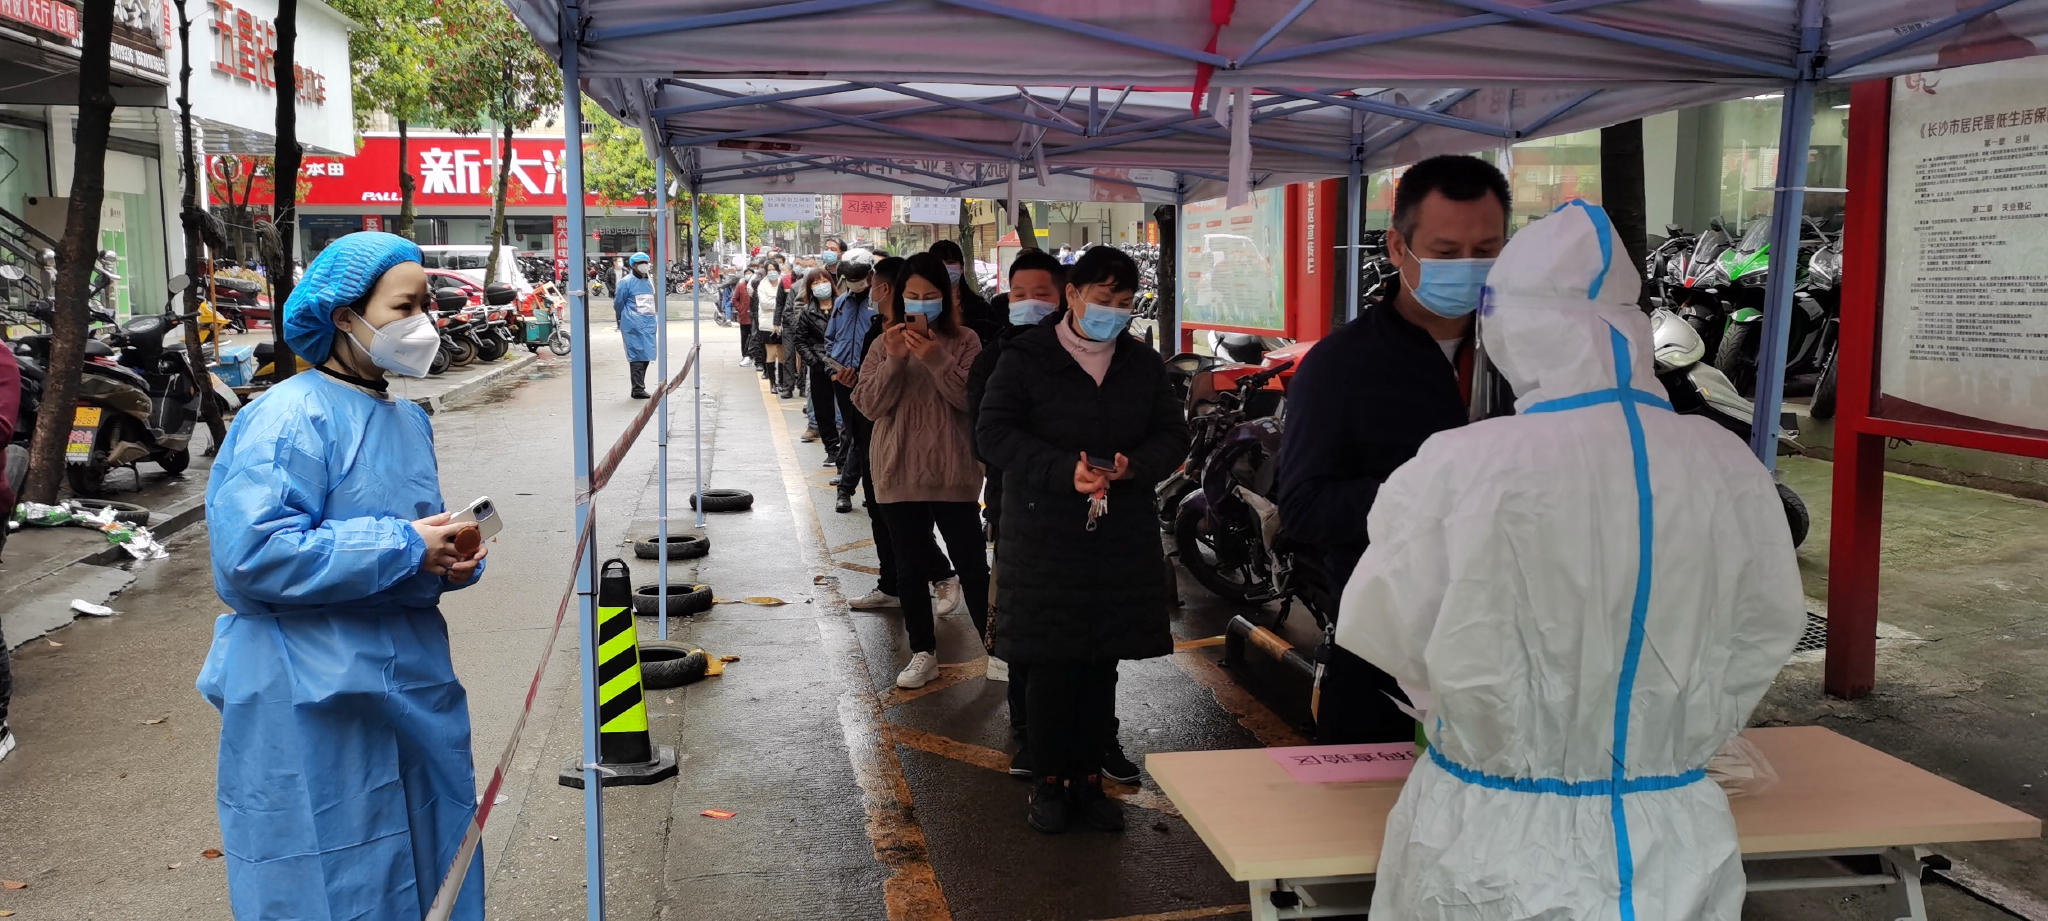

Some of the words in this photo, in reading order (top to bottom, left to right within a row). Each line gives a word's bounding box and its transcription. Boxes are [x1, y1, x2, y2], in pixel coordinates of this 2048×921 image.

[30, 0, 51, 26] 大厅
[57, 7, 76, 35] 包厢
[207, 0, 327, 104] 五星钻电动车
[1919, 107, 2048, 138] 《长沙市居民最低生活保
